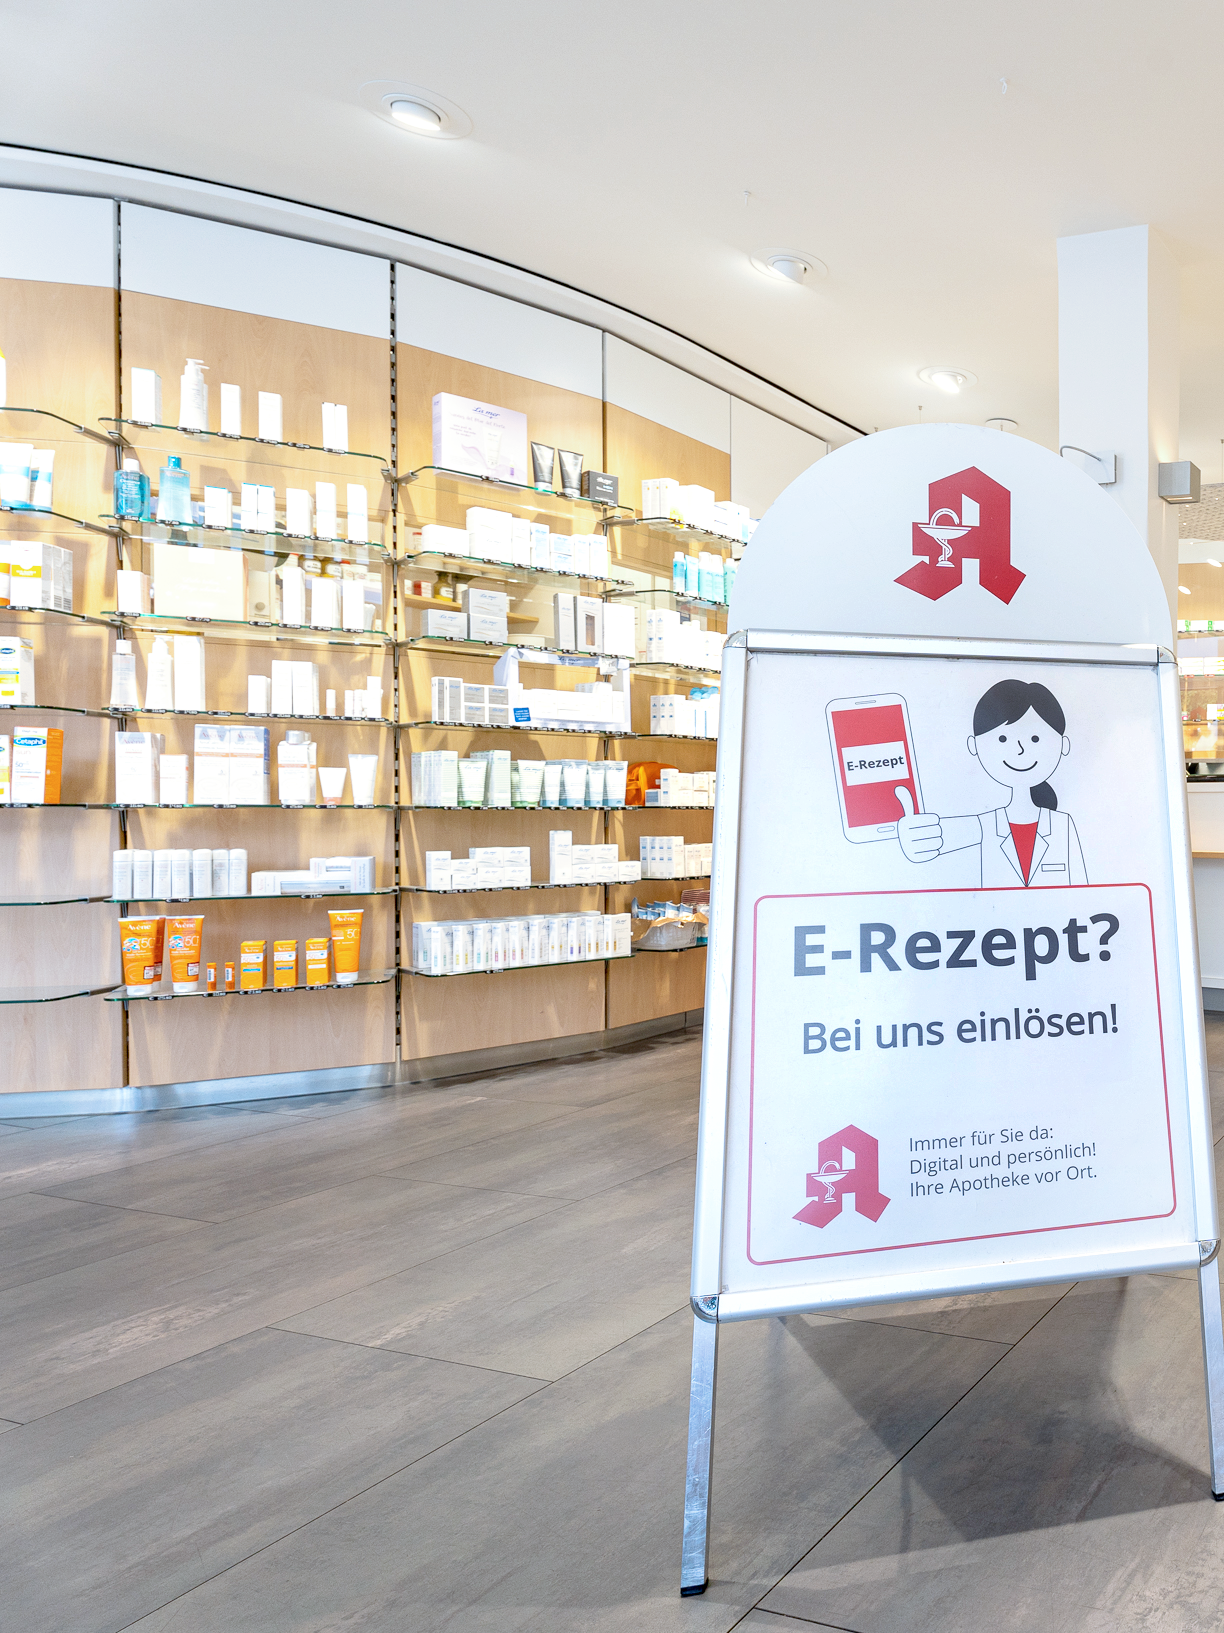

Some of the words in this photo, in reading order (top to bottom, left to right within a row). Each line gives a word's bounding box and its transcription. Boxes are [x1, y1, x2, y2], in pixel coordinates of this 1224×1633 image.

[16, 738, 43, 746] Cetaphil
[847, 756, 904, 771] E-Rezept
[794, 913, 1119, 981] E-Rezept?
[804, 1019, 860, 1054] Bei
[877, 1021, 944, 1049] uns
[957, 1004, 1118, 1043] einlösen!
[910, 1136, 966, 1152] Immer
[971, 1131, 995, 1146] für
[1000, 1128, 1023, 1143] Sie
[1029, 1126, 1053, 1140] da:
[910, 1155, 962, 1177] Digital
[969, 1151, 1001, 1168] und
[1007, 1142, 1096, 1169] persönlich!
[911, 1181, 944, 1197] Ihre
[949, 1171, 1029, 1196] Apotheke
[1035, 1171, 1061, 1183] vor
[1067, 1166, 1096, 1180] Ort.
